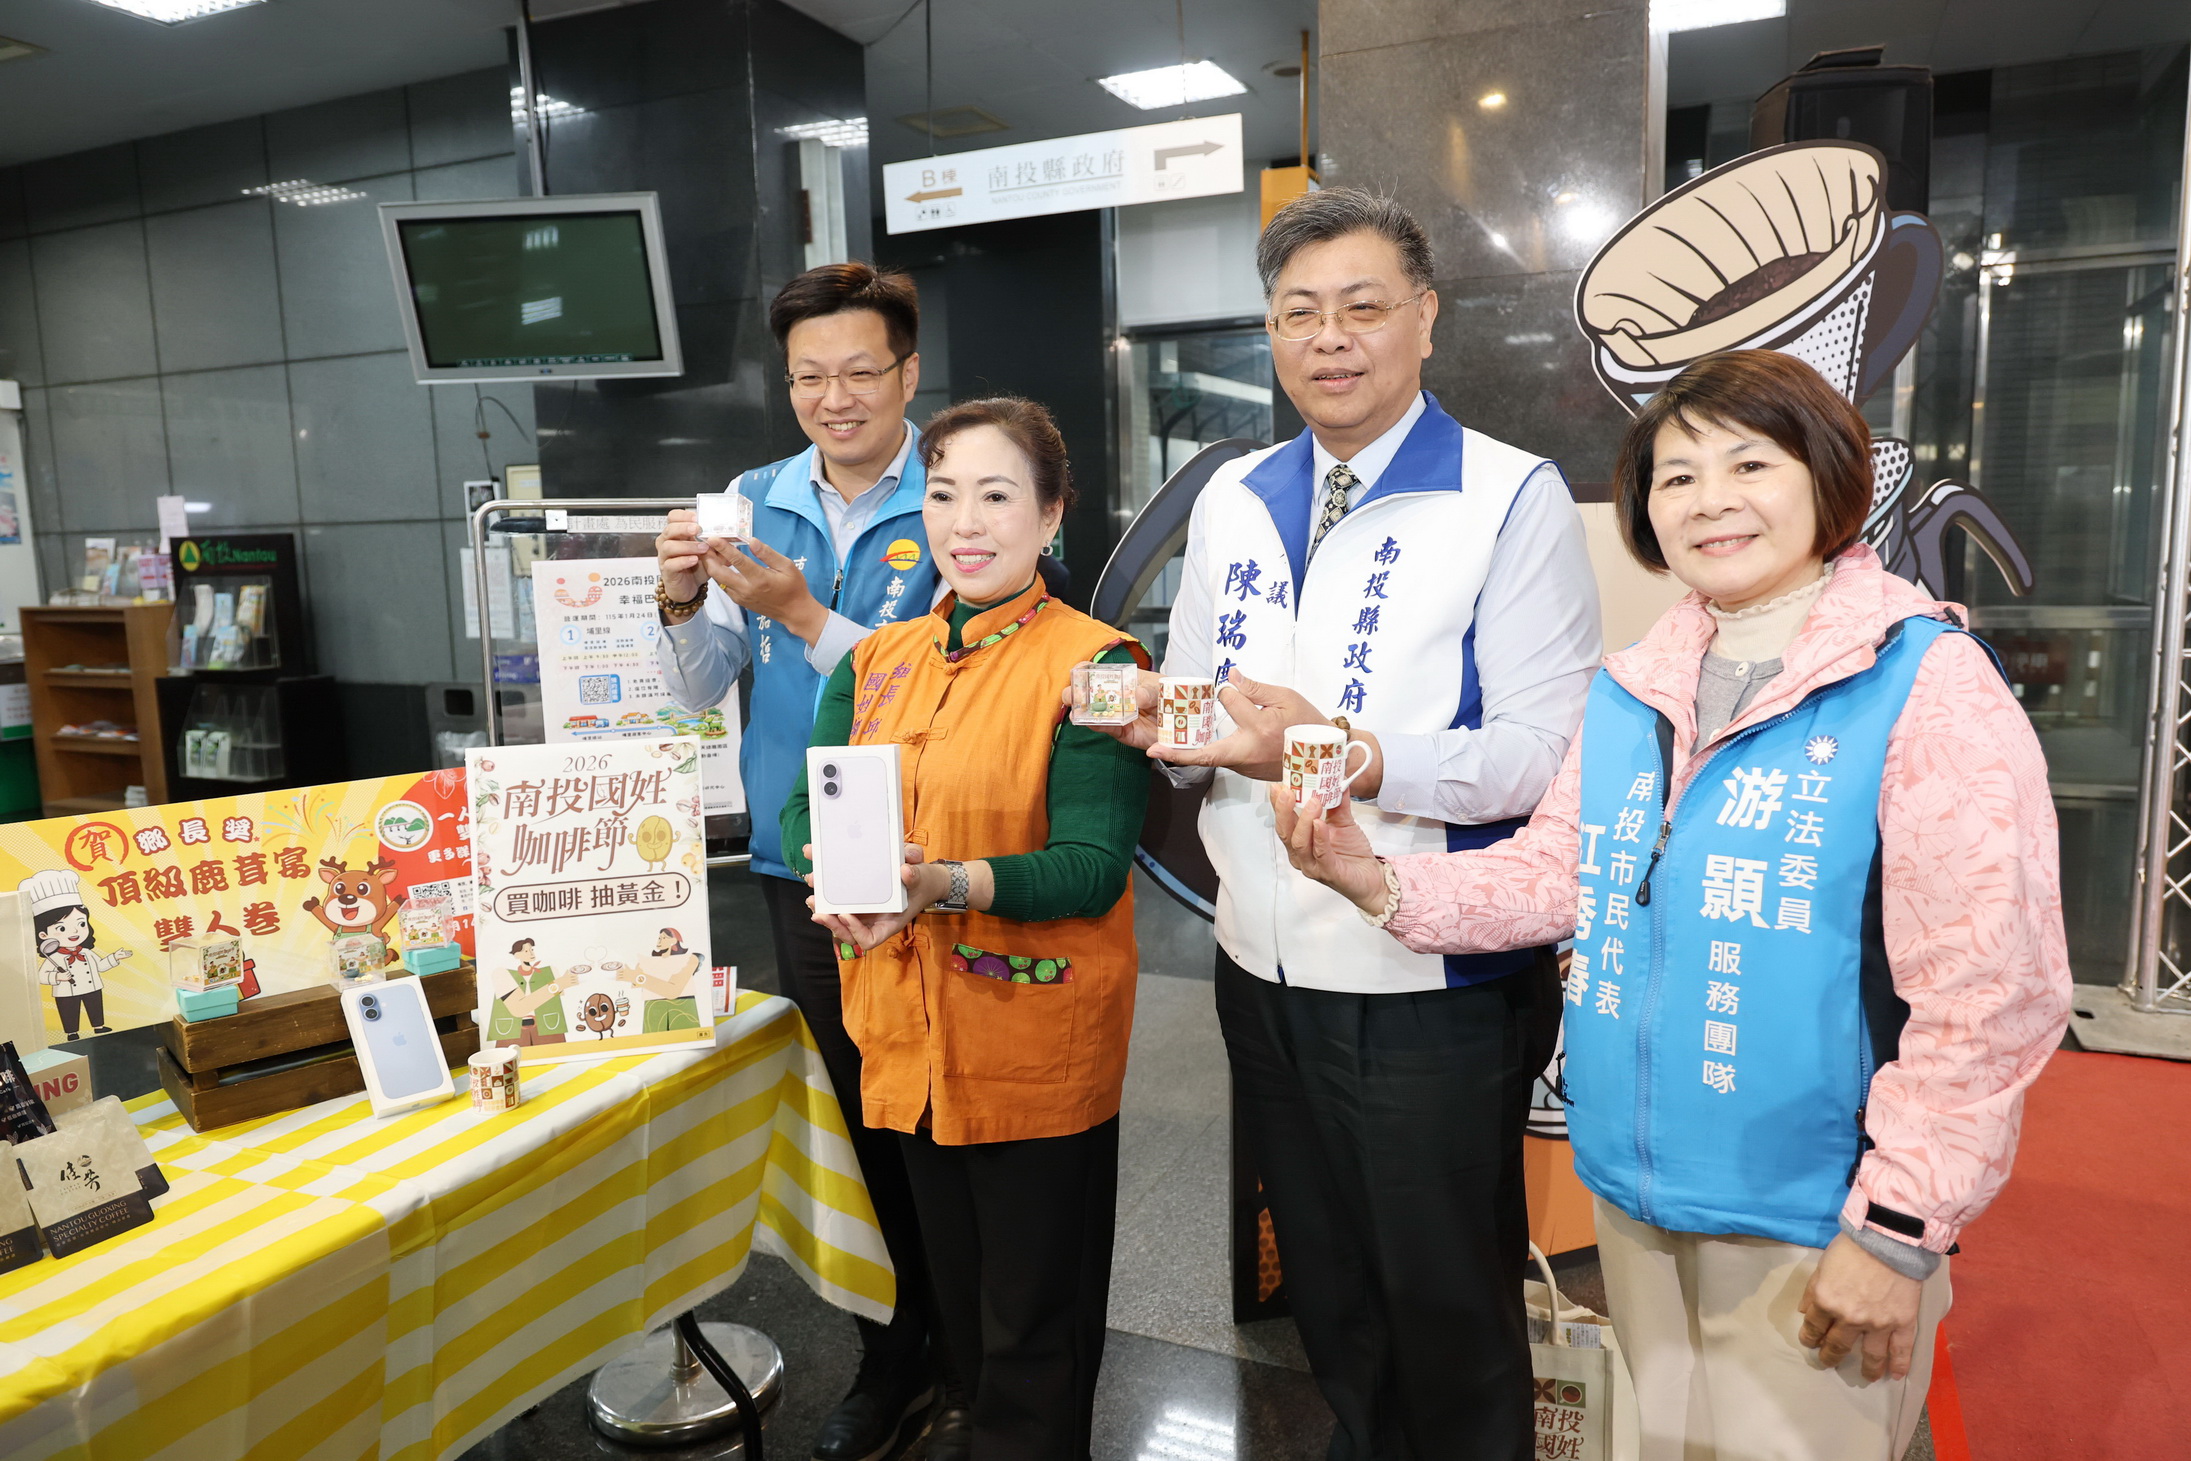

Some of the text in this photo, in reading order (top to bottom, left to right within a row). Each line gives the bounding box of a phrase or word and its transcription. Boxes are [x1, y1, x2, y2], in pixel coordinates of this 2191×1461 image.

[987, 148, 1125, 190] 南投縣政府
[603, 575, 661, 587] 2026南投
[874, 575, 906, 629] 南投
[567, 630, 574, 640] 1
[647, 626, 655, 636] 2
[1337, 536, 1401, 714] 南投縣政府
[562, 753, 613, 774] 2026
[503, 767, 673, 824] 南投國姓
[78, 828, 115, 864] 賀
[500, 815, 628, 876] 咖啡節
[1699, 766, 1788, 930] 游顥
[1774, 768, 1832, 935] 立法委員
[506, 887, 583, 917] 買咖啡
[1702, 939, 1742, 1095] 服務團隊
[50, 1216, 88, 1235] NANTOU
[87, 1200, 127, 1220] GUOXING
[53, 1220, 97, 1242] SPECIALTY
[98, 1207, 129, 1224] COFFEE
[1534, 1405, 1584, 1434] 南投
